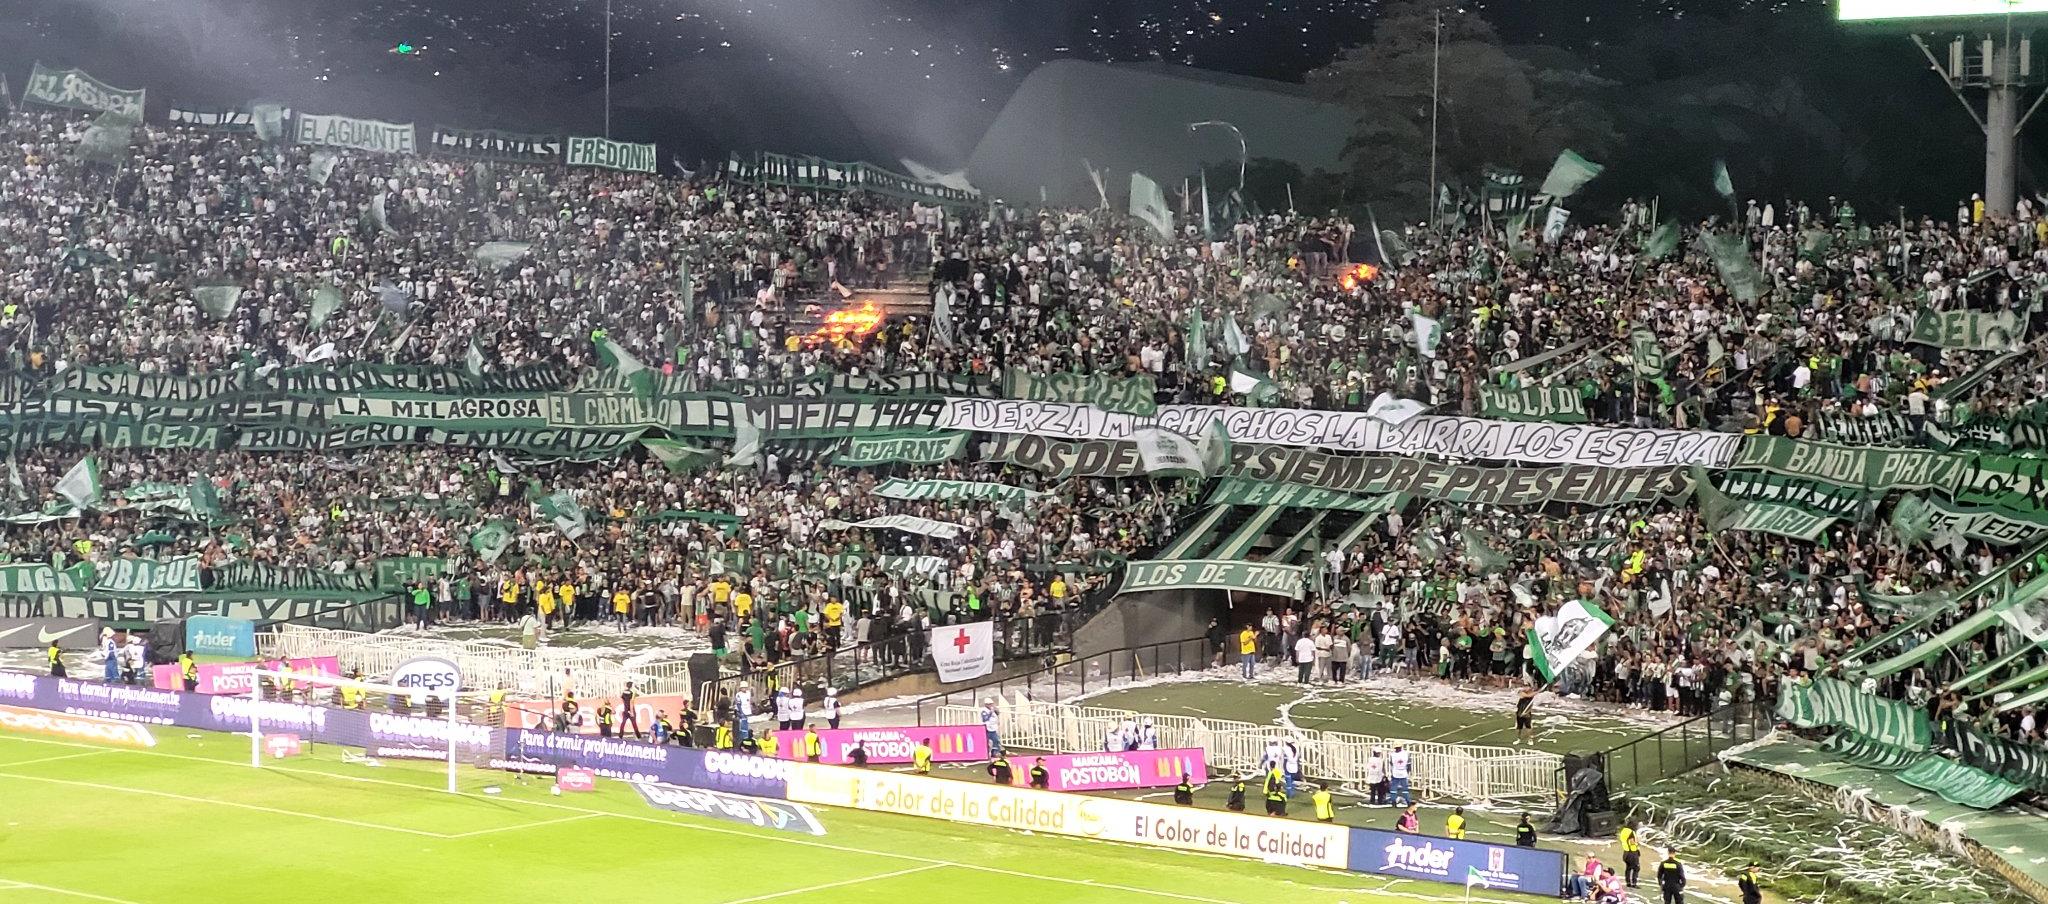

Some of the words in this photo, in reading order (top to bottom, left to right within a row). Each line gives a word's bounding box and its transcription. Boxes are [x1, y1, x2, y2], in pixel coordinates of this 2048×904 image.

[301, 117, 322, 142] EL
[325, 119, 411, 152] AGUANTE
[570, 138, 657, 172] FREDONIA
[64, 366, 91, 392] EL
[97, 370, 240, 401] SALVADOR
[842, 371, 982, 397] CASTILLA
[337, 397, 369, 417] LA
[391, 397, 541, 420] MILAGROSA
[551, 400, 576, 425] EL
[584, 397, 671, 427] CARMELO
[680, 399, 735, 435] LA
[745, 398, 861, 434] MAFIA
[869, 398, 945, 433] 1989
[100, 421, 132, 448] LA
[140, 423, 219, 450] CEJA
[250, 424, 417, 450] RIONEGRO
[444, 427, 627, 450] ENVIGADO
[949, 399, 1091, 438] FUERZA
[1377, 416, 1503, 458] BARRA
[1505, 423, 1579, 460] LOS
[854, 438, 949, 462] GUARNE
[1743, 437, 1776, 465] LA
[1785, 442, 1868, 484] BANDA
[1877, 452, 1963, 490] PIRATA
[1251, 446, 1444, 499] SIEMPRE
[1443, 464, 1692, 505] PRESENTES
[103, 556, 199, 591] IBAGUE
[1133, 563, 1188, 586] LOS
[1195, 563, 1228, 585] DE
[519, 729, 545, 748] Para
[583, 739, 668, 761] profundamente
[1072, 755, 1119, 768] MANZANA
[876, 783, 923, 810] Color
[930, 789, 954, 815] de
[962, 791, 980, 818] la
[987, 795, 1064, 829] Calidad
[1135, 815, 1149, 838] El
[1155, 819, 1201, 844] Color
[1206, 823, 1227, 848] de
[1234, 826, 1250, 850] la
[1257, 830, 1327, 860] Calidad
[1384, 837, 1455, 870] inder
